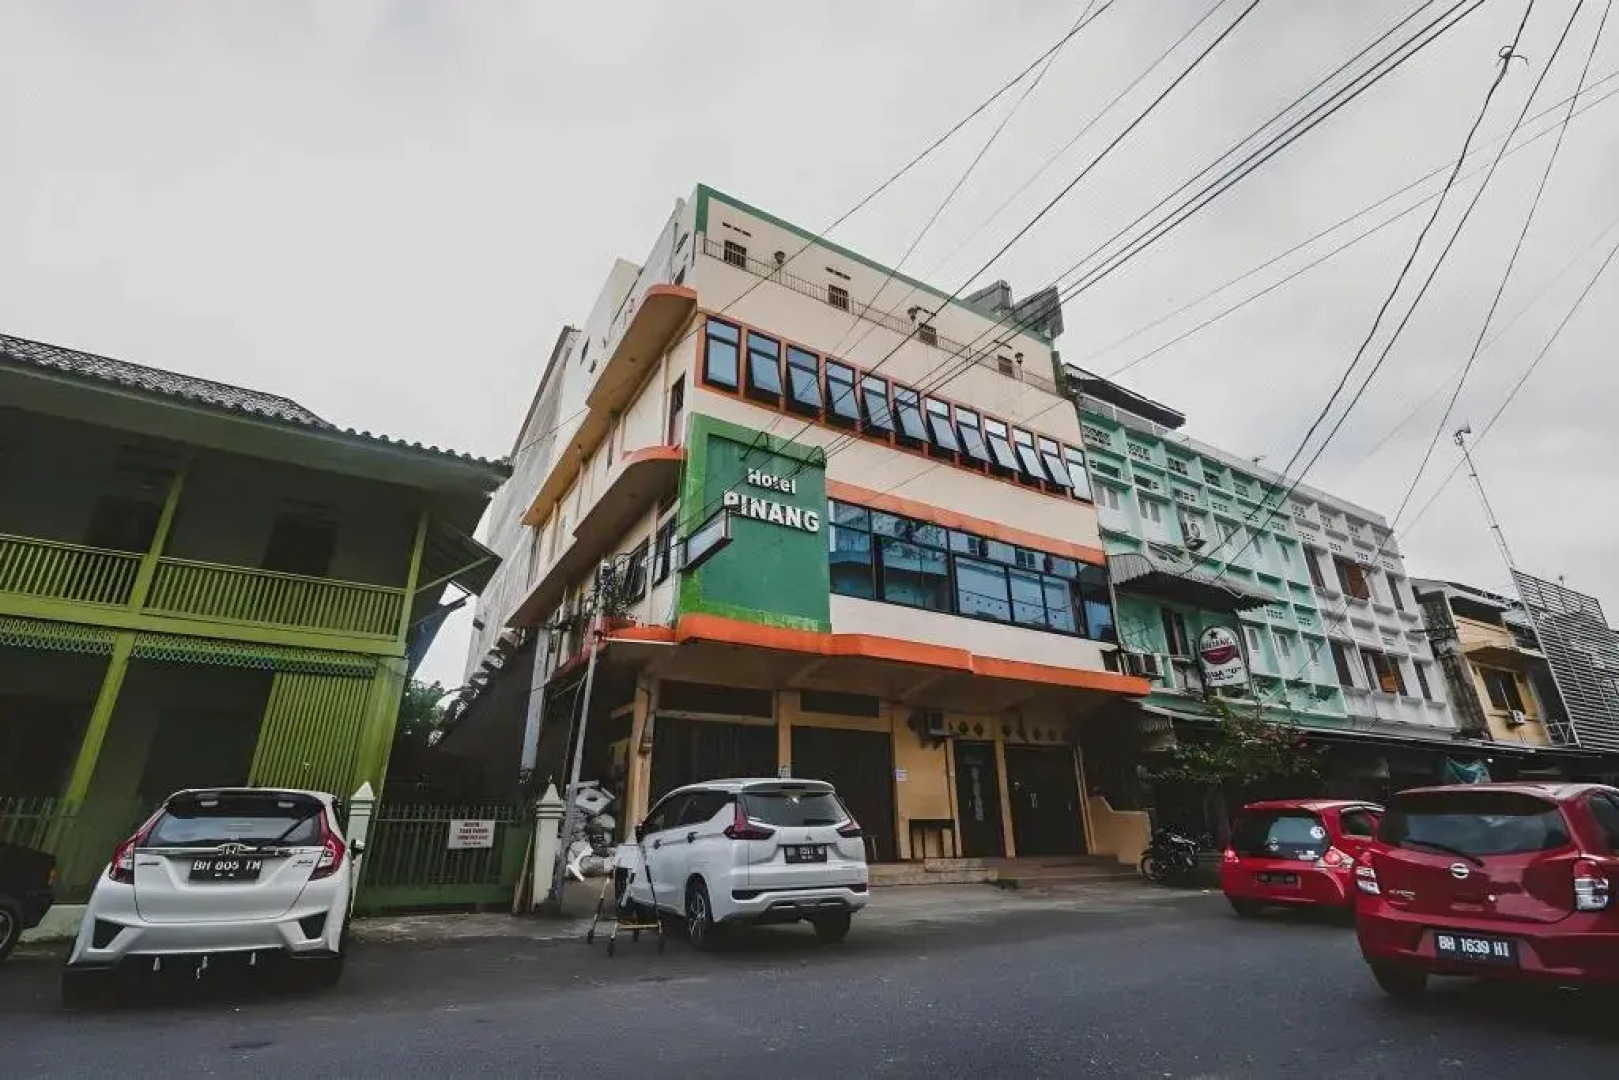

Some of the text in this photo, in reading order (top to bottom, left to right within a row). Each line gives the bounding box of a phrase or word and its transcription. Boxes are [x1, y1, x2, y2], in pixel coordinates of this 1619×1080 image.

[747, 467, 796, 494] Hotel
[724, 490, 820, 532] PINANG
[1438, 935, 1509, 957] BH 1639 HI
